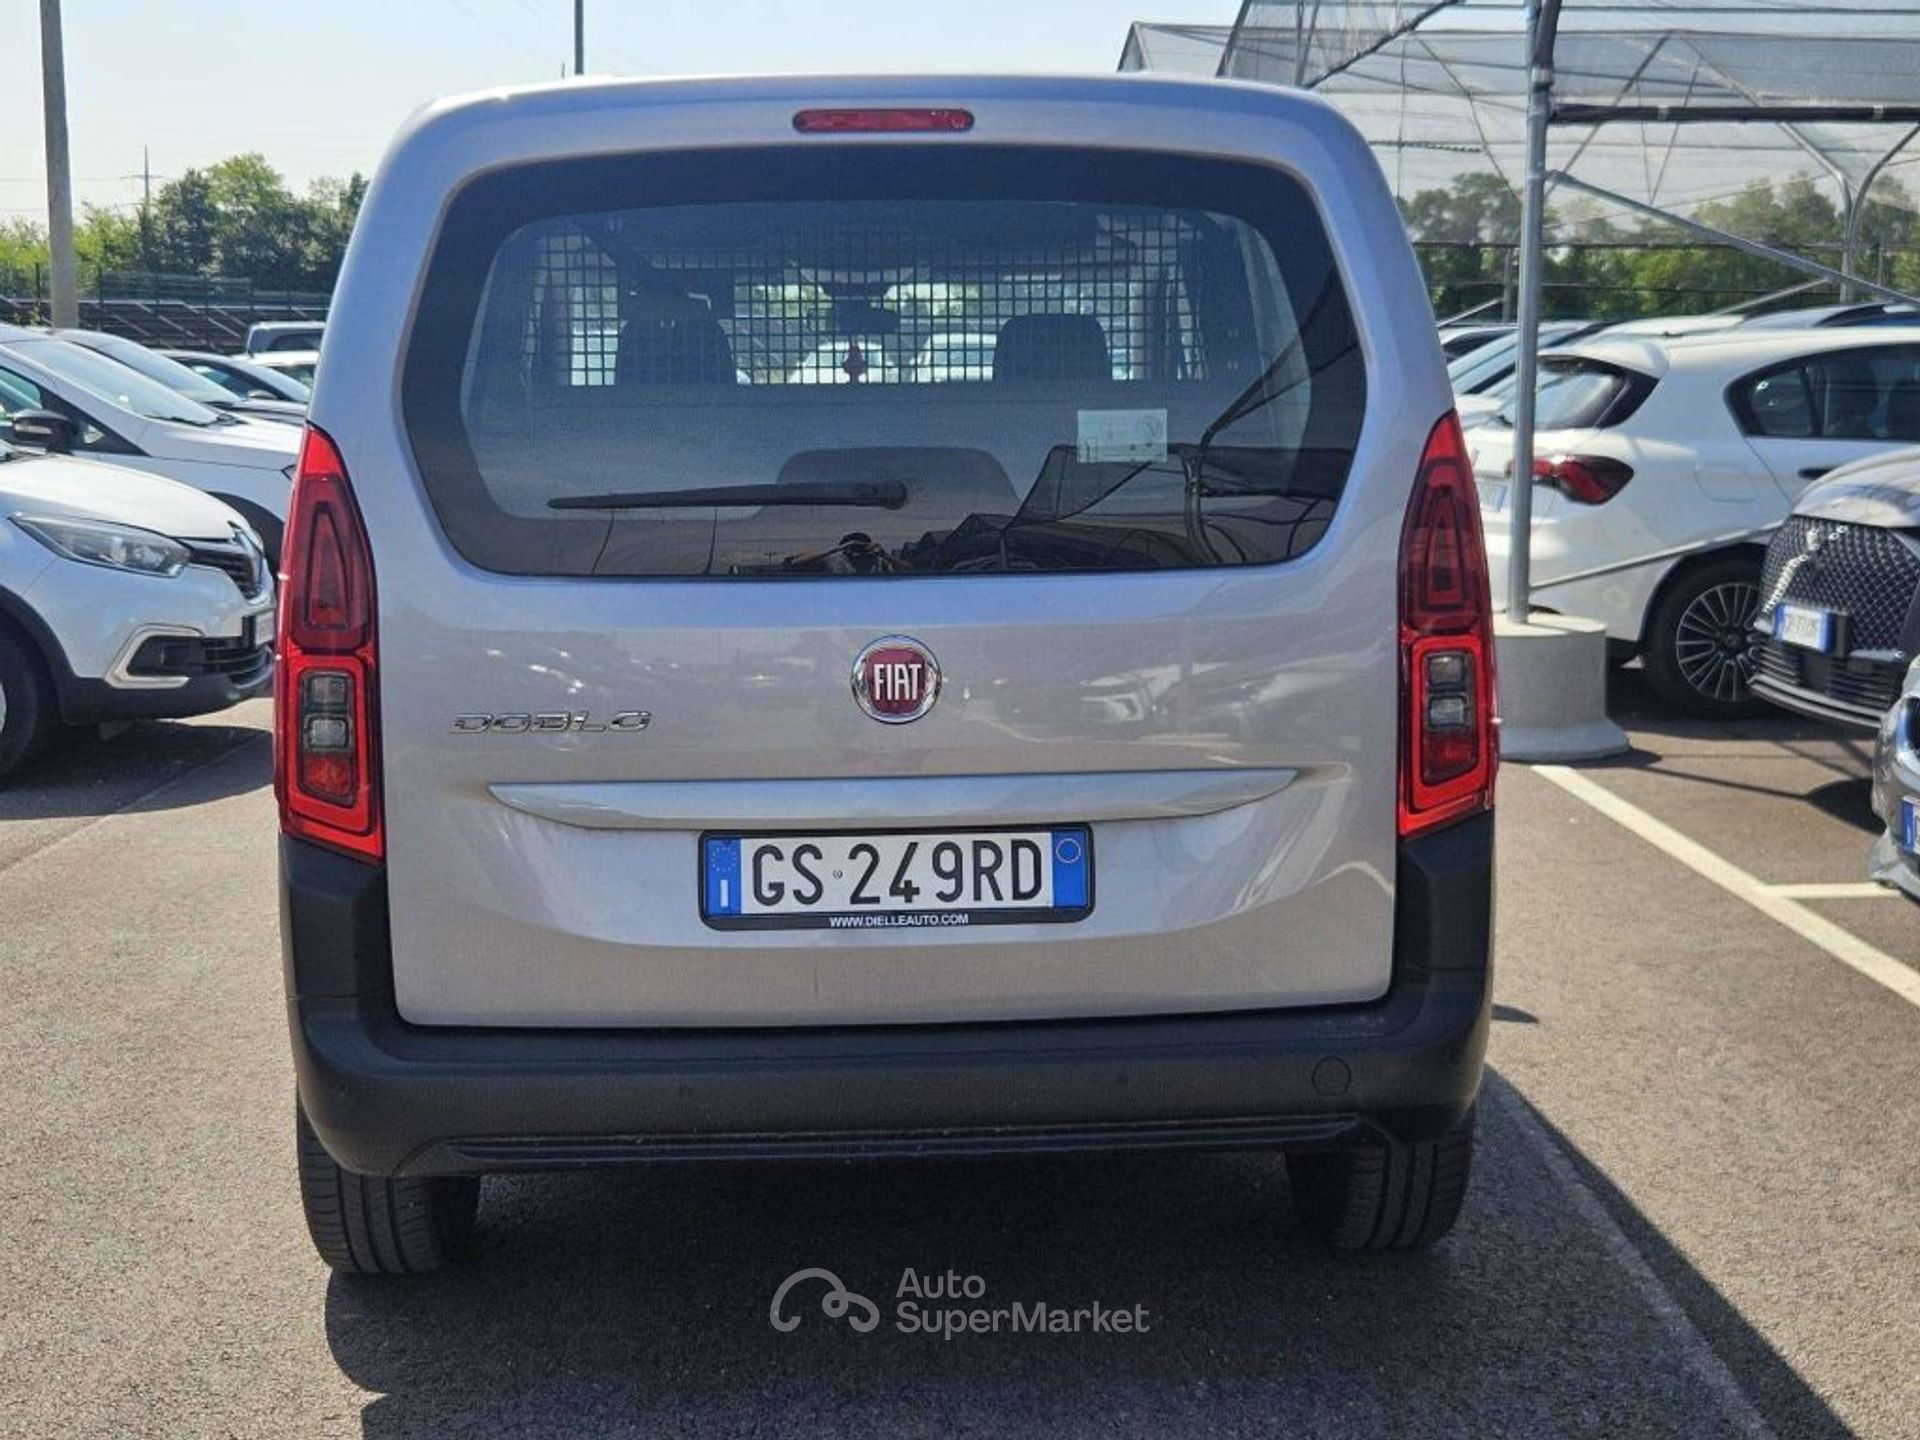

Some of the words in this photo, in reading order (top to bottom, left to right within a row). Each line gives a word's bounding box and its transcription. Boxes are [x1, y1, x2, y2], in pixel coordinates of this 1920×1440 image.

[873, 663, 922, 701] FIAT
[751, 843, 824, 906] GS
[847, 839, 1043, 905] 249RD
[828, 912, 970, 928] WWW.DIELLEAUTO.COM
